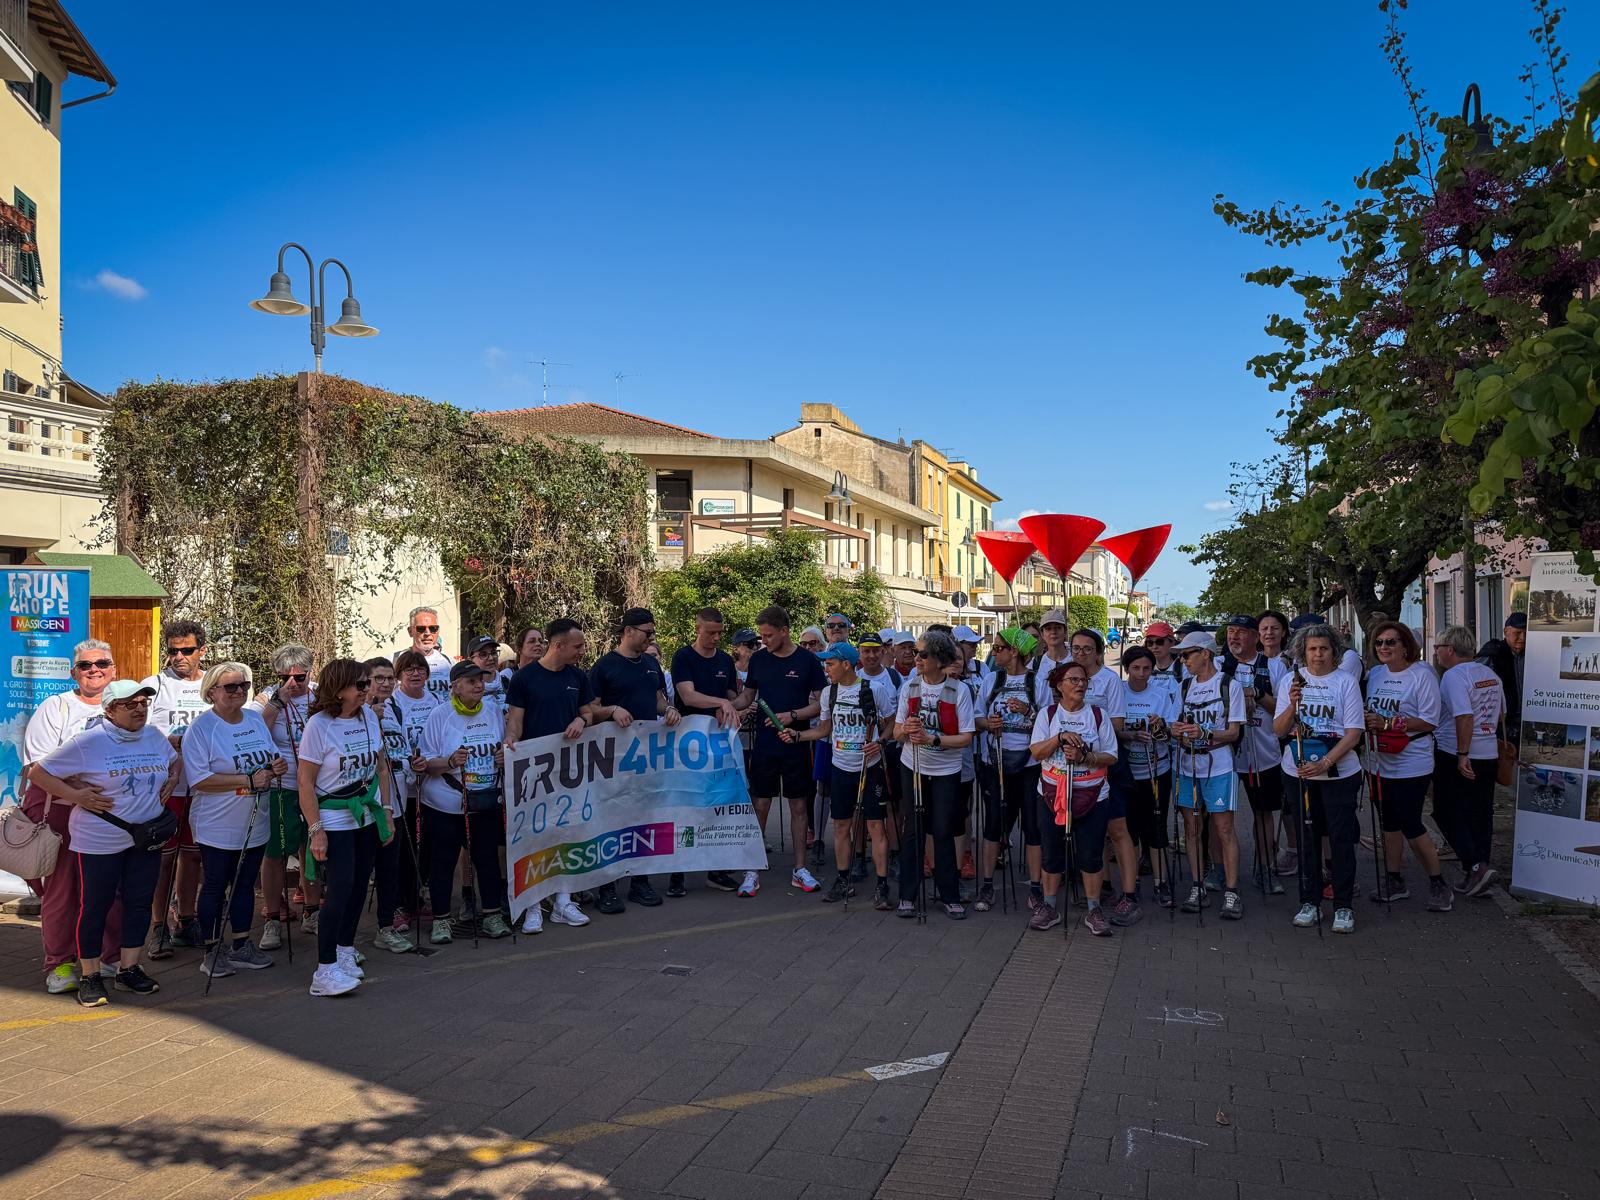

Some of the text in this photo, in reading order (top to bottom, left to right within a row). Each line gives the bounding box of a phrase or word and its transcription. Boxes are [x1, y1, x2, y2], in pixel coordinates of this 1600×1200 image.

[1544, 559, 1576, 567] www.di
[10, 598, 70, 615] 4HOPE
[16, 620, 65, 630] MASSIGEN
[427, 680, 449, 691] UN
[1534, 689, 1600, 701] Se vuoi mettere
[1367, 696, 1401, 713] RUN
[1526, 698, 1547, 707] piedi
[1549, 699, 1571, 710] inizia
[1299, 703, 1335, 720] RUN
[232, 729, 256, 738] GIVOVA
[714, 804, 756, 817] VI EDIZ
[511, 789, 593, 846] 2026
[524, 829, 656, 886] MASSIGEN
